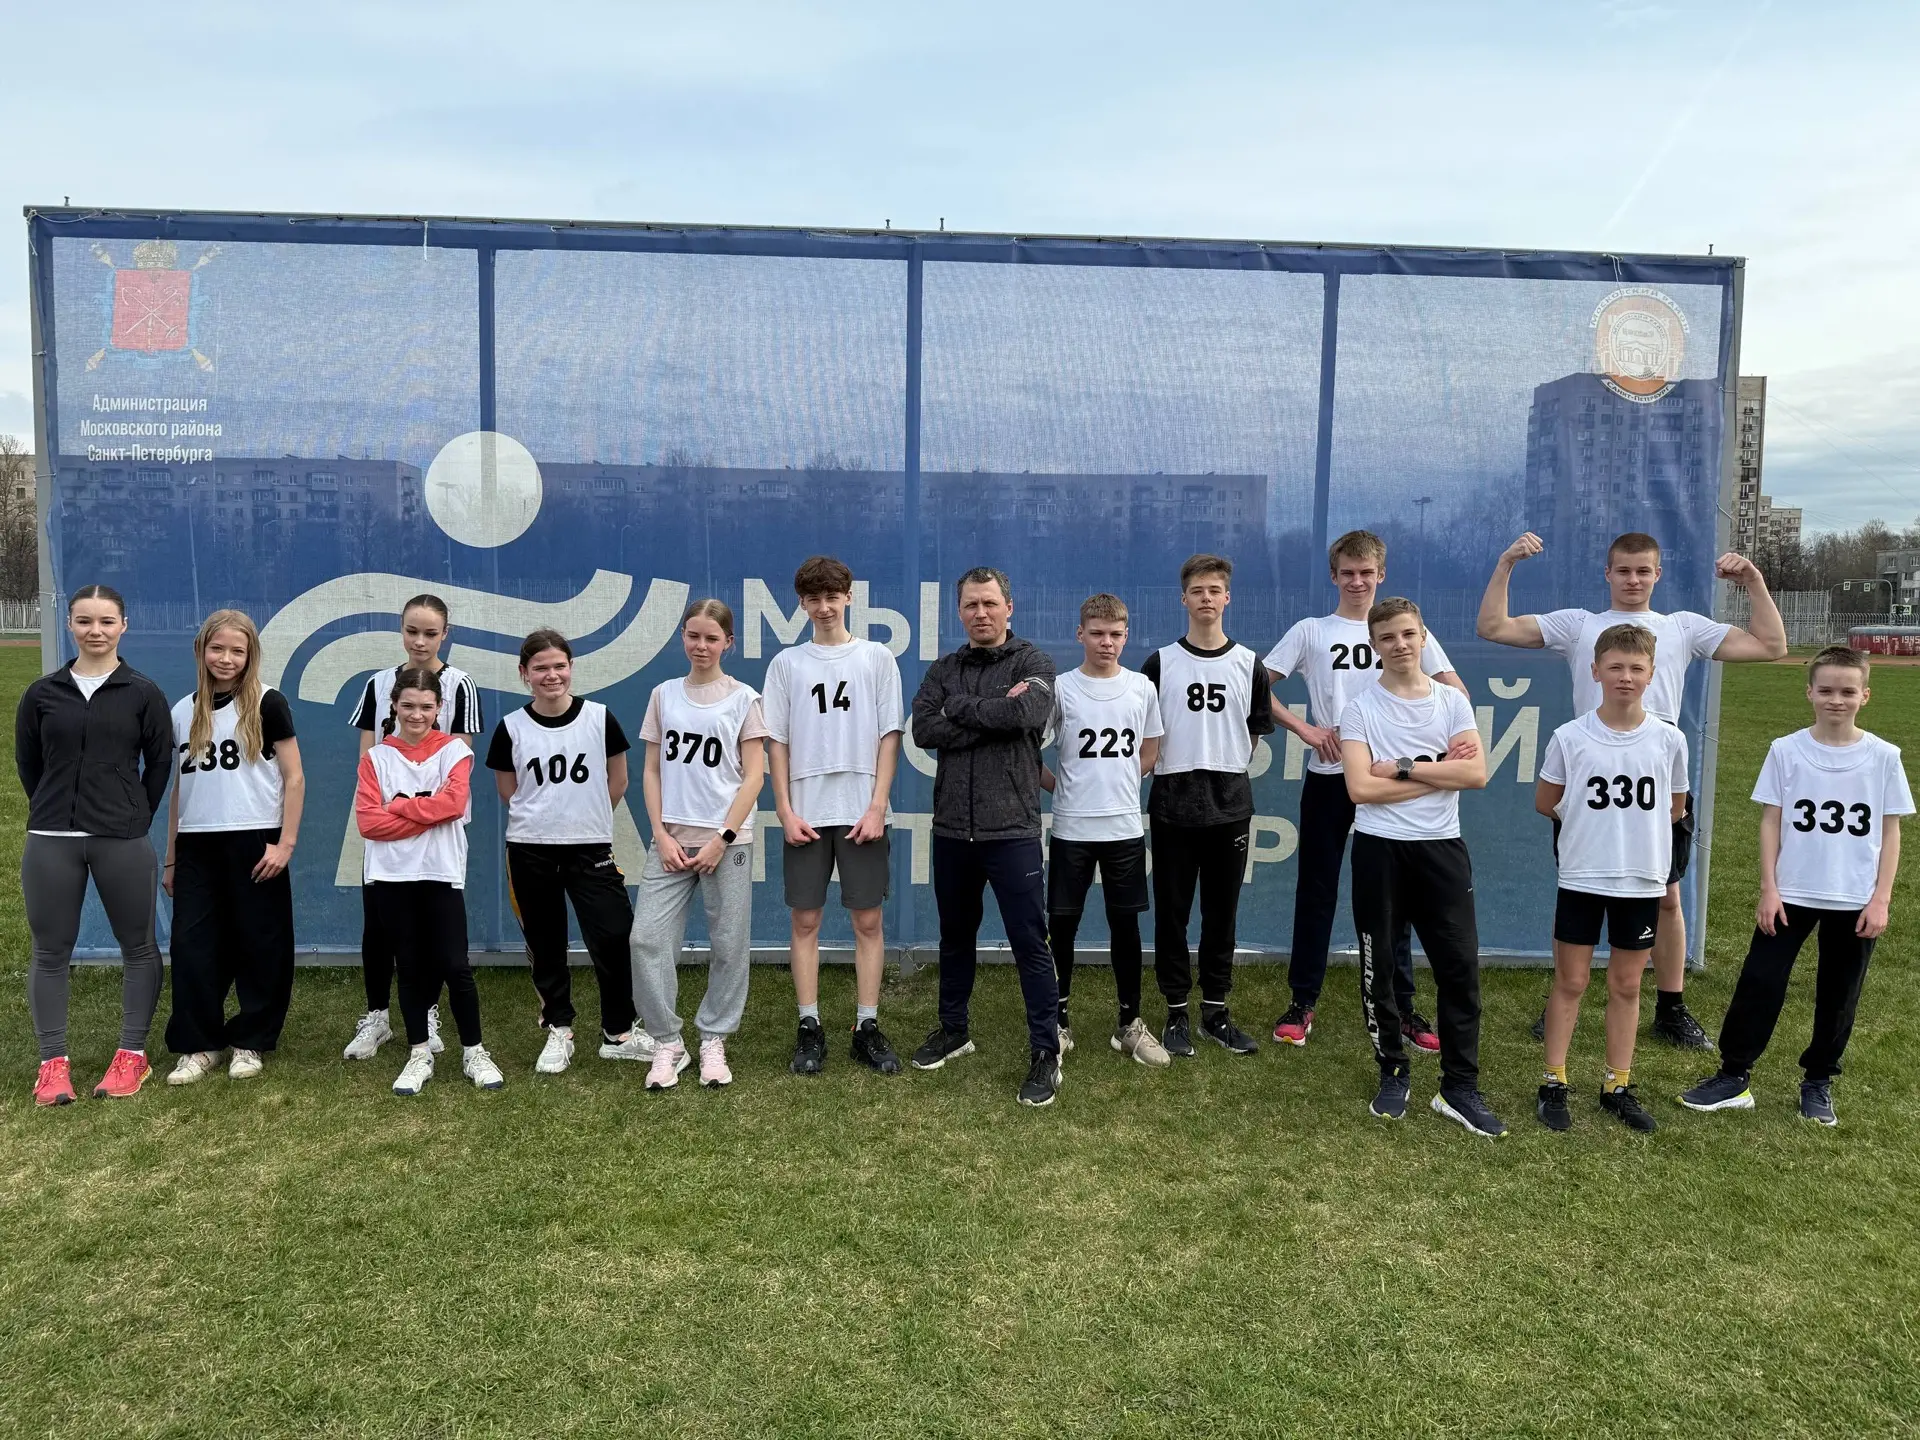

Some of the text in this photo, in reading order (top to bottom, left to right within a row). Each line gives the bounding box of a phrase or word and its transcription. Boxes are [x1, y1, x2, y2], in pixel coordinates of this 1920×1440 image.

[92, 394, 207, 413] Администрация
[80, 420, 222, 439] Московского района
[88, 444, 213, 464] Санкт-Петербурга
[743, 578, 940, 661] МЫ
[1872, 635, 1888, 643] 1941
[1330, 643, 1383, 670] 20
[812, 681, 851, 714] 14
[1186, 683, 1226, 712] 85
[179, 739, 240, 774] 238
[665, 729, 723, 768] 370
[1078, 728, 1136, 760] 223
[526, 752, 590, 787] 106
[1587, 775, 1656, 811] 330
[1792, 799, 1872, 837] 333
